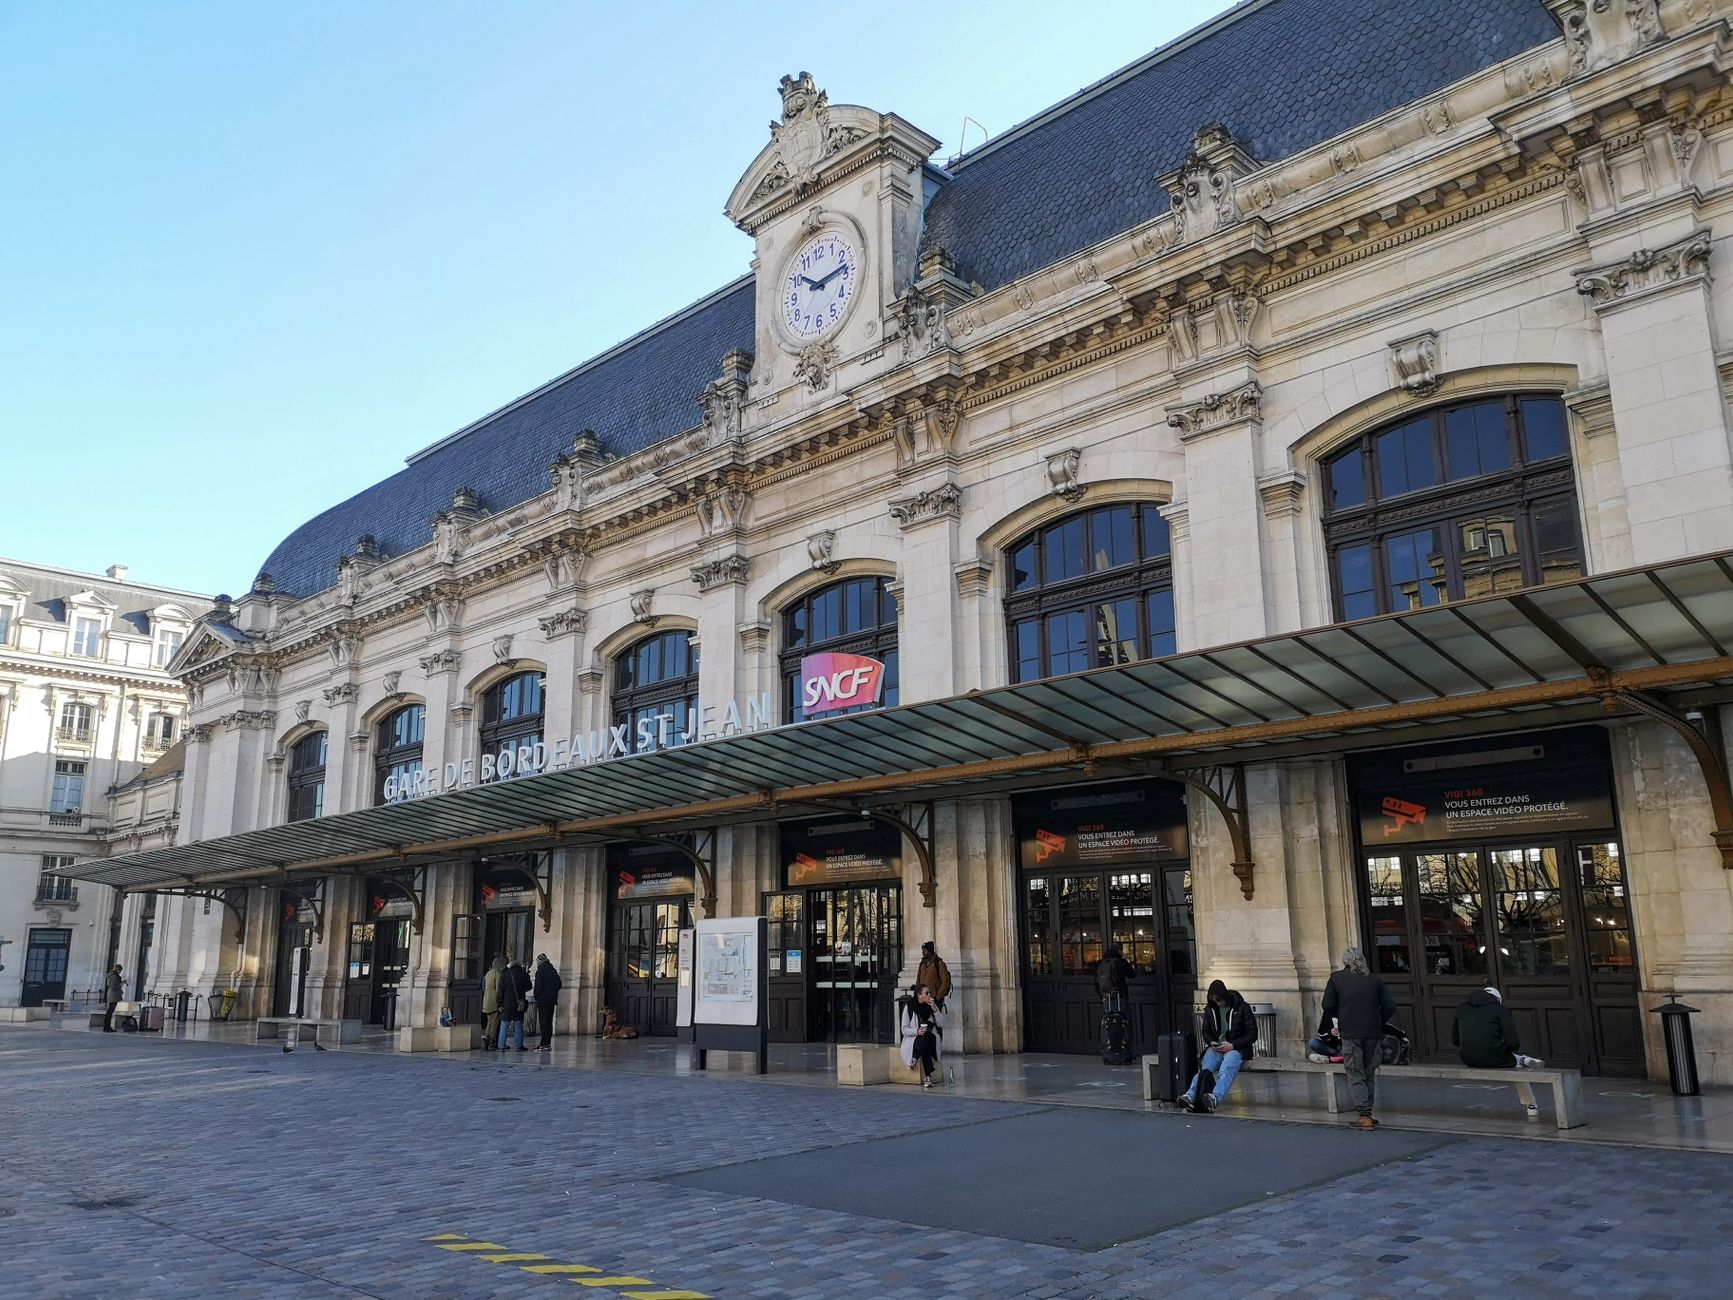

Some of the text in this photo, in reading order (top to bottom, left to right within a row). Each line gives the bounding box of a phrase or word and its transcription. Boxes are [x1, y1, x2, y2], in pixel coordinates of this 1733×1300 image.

[813, 246, 824, 261] 12
[829, 243, 834, 256] 1
[802, 255, 810, 271] 11
[838, 250, 846, 264] 2
[842, 265, 849, 280] 3
[793, 274, 803, 288] 10
[838, 285, 845, 298] 4
[791, 293, 798, 306] 9
[794, 309, 801, 322] 8
[830, 303, 837, 317] 5
[804, 315, 811, 330] 7
[815, 315, 823, 328] 6
[803, 666, 874, 706] SNCF
[383, 692, 771, 800] GARE DE BORDEAUX ST JEAN
[1444, 789, 1463, 799] VIGI
[1445, 795, 1530, 809] VOUS ENTREZ DANS
[1446, 801, 1569, 819] UN ESPACE VIDÉO PROTÉGÉ.
[1078, 832, 1094, 840] VOUS
[1095, 831, 1118, 839] ENTREZ
[1088, 840, 1110, 848] ESPACE
[1110, 838, 1130, 846] VIDÉO
[1130, 835, 1160, 845] PROTÉGÉ.
